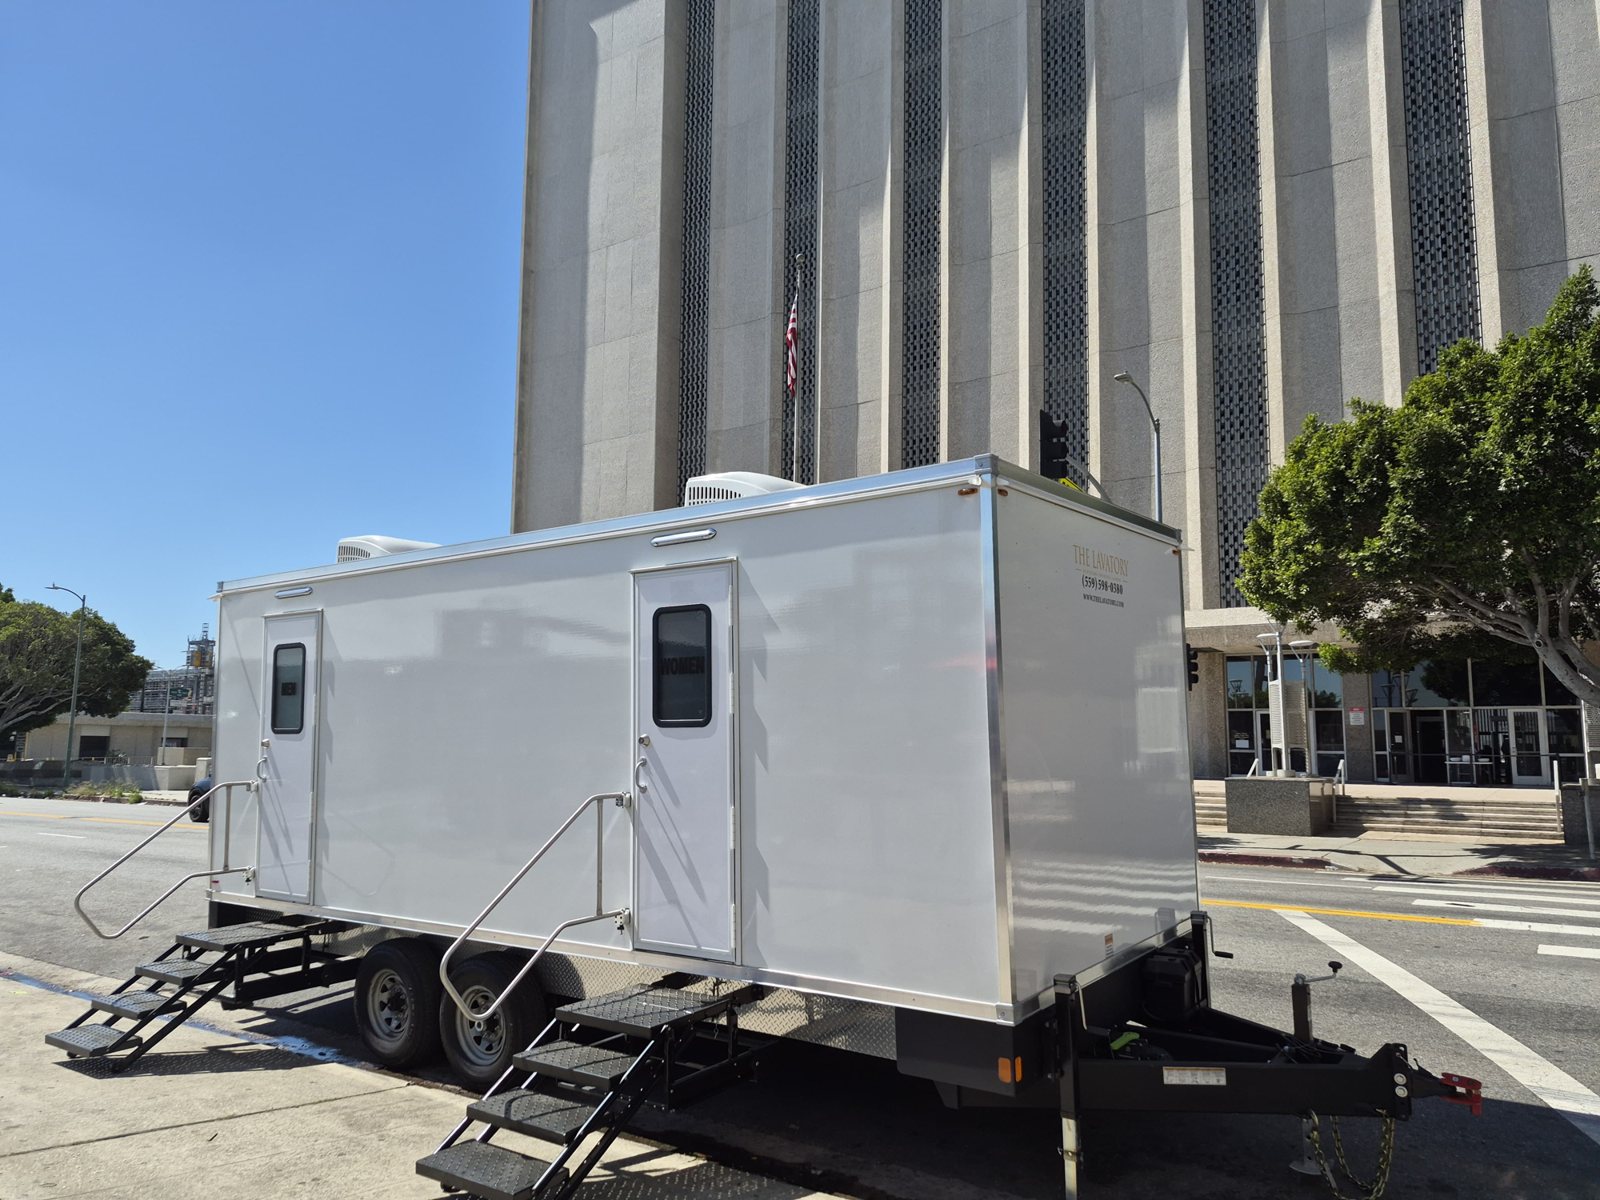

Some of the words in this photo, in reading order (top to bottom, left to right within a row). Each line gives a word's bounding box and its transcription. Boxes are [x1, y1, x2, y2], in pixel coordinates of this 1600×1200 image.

[1072, 544, 1090, 567] THE
[1092, 550, 1128, 577] LAVATORY
[656, 656, 705, 675] WOMEN
